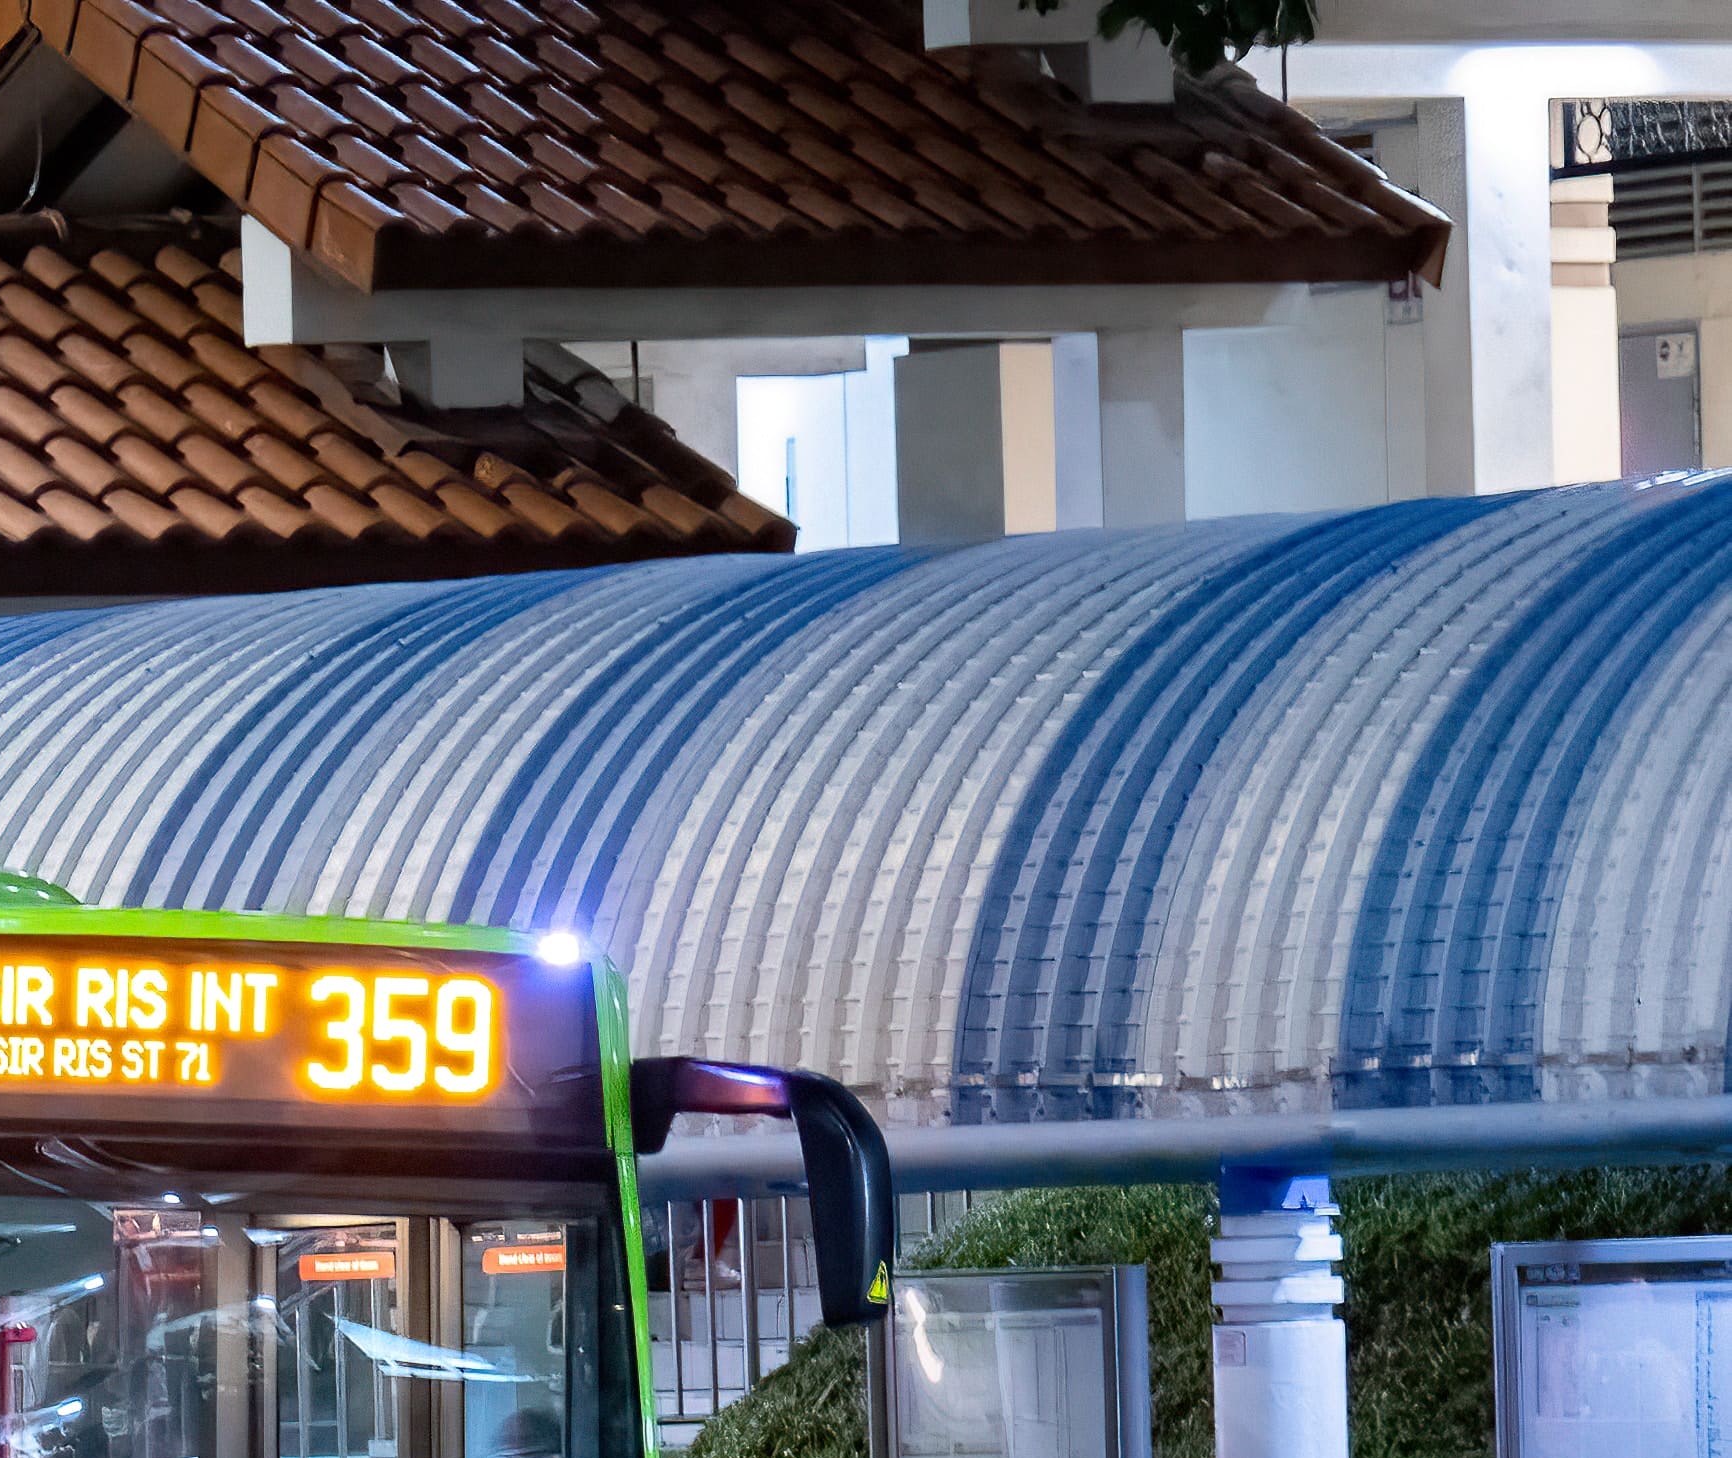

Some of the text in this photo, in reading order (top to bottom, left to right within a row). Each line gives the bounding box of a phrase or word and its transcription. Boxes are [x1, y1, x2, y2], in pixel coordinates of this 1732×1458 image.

[76, 967, 169, 1030] RIS
[189, 970, 279, 1033] INT
[52, 1037, 113, 1078] RIS
[121, 1039, 166, 1080] ST
[175, 1041, 211, 1082] 71
[307, 975, 493, 1094] 359
